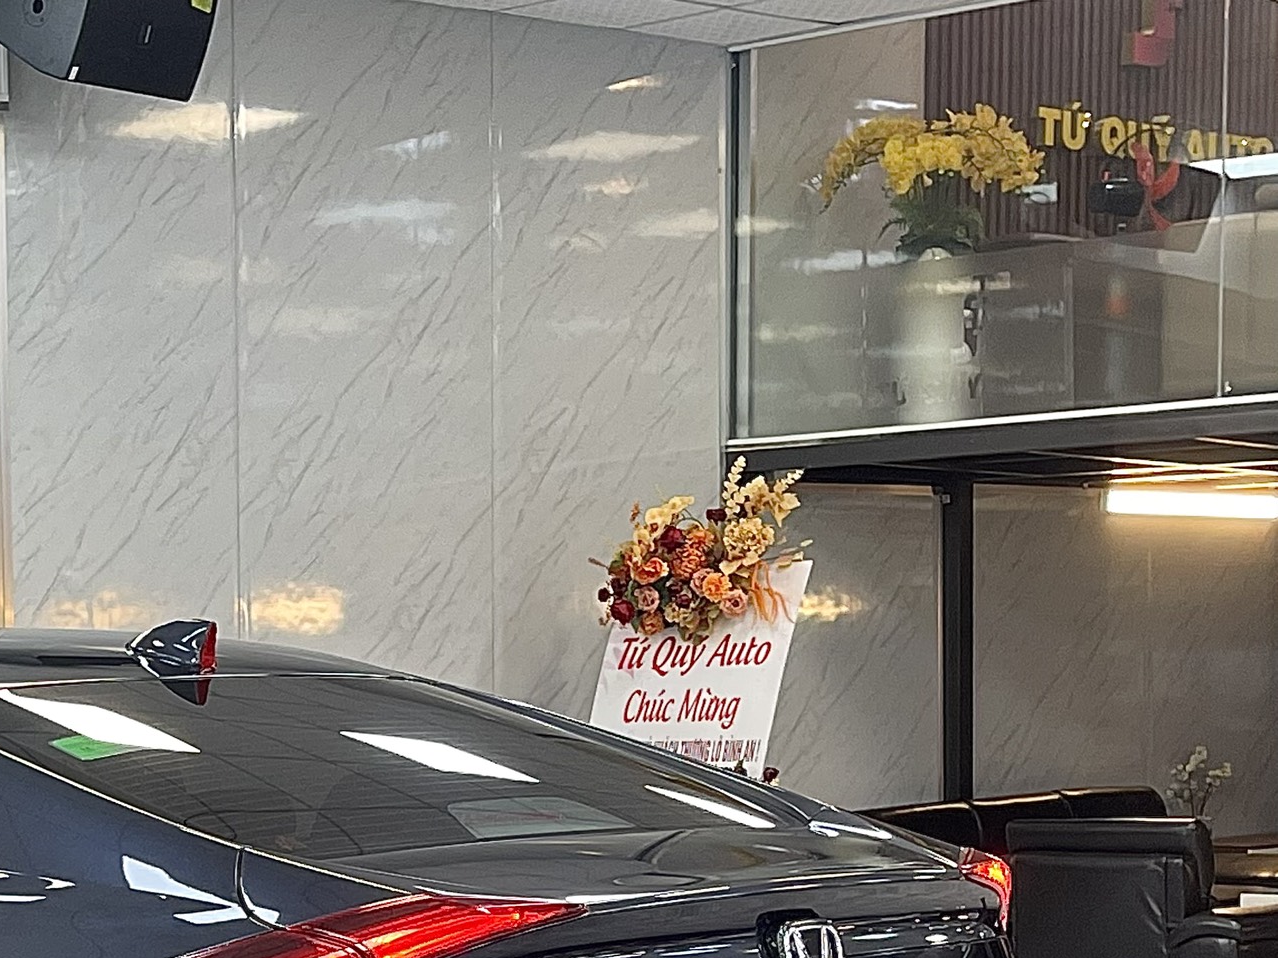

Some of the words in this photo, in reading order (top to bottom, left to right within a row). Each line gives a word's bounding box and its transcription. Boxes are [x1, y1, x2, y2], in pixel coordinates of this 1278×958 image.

[617, 636, 650, 670] Tứ
[651, 636, 707, 676] Quý
[706, 633, 772, 667] Auto
[623, 689, 675, 723] Chúc
[677, 687, 741, 729] Mừng
